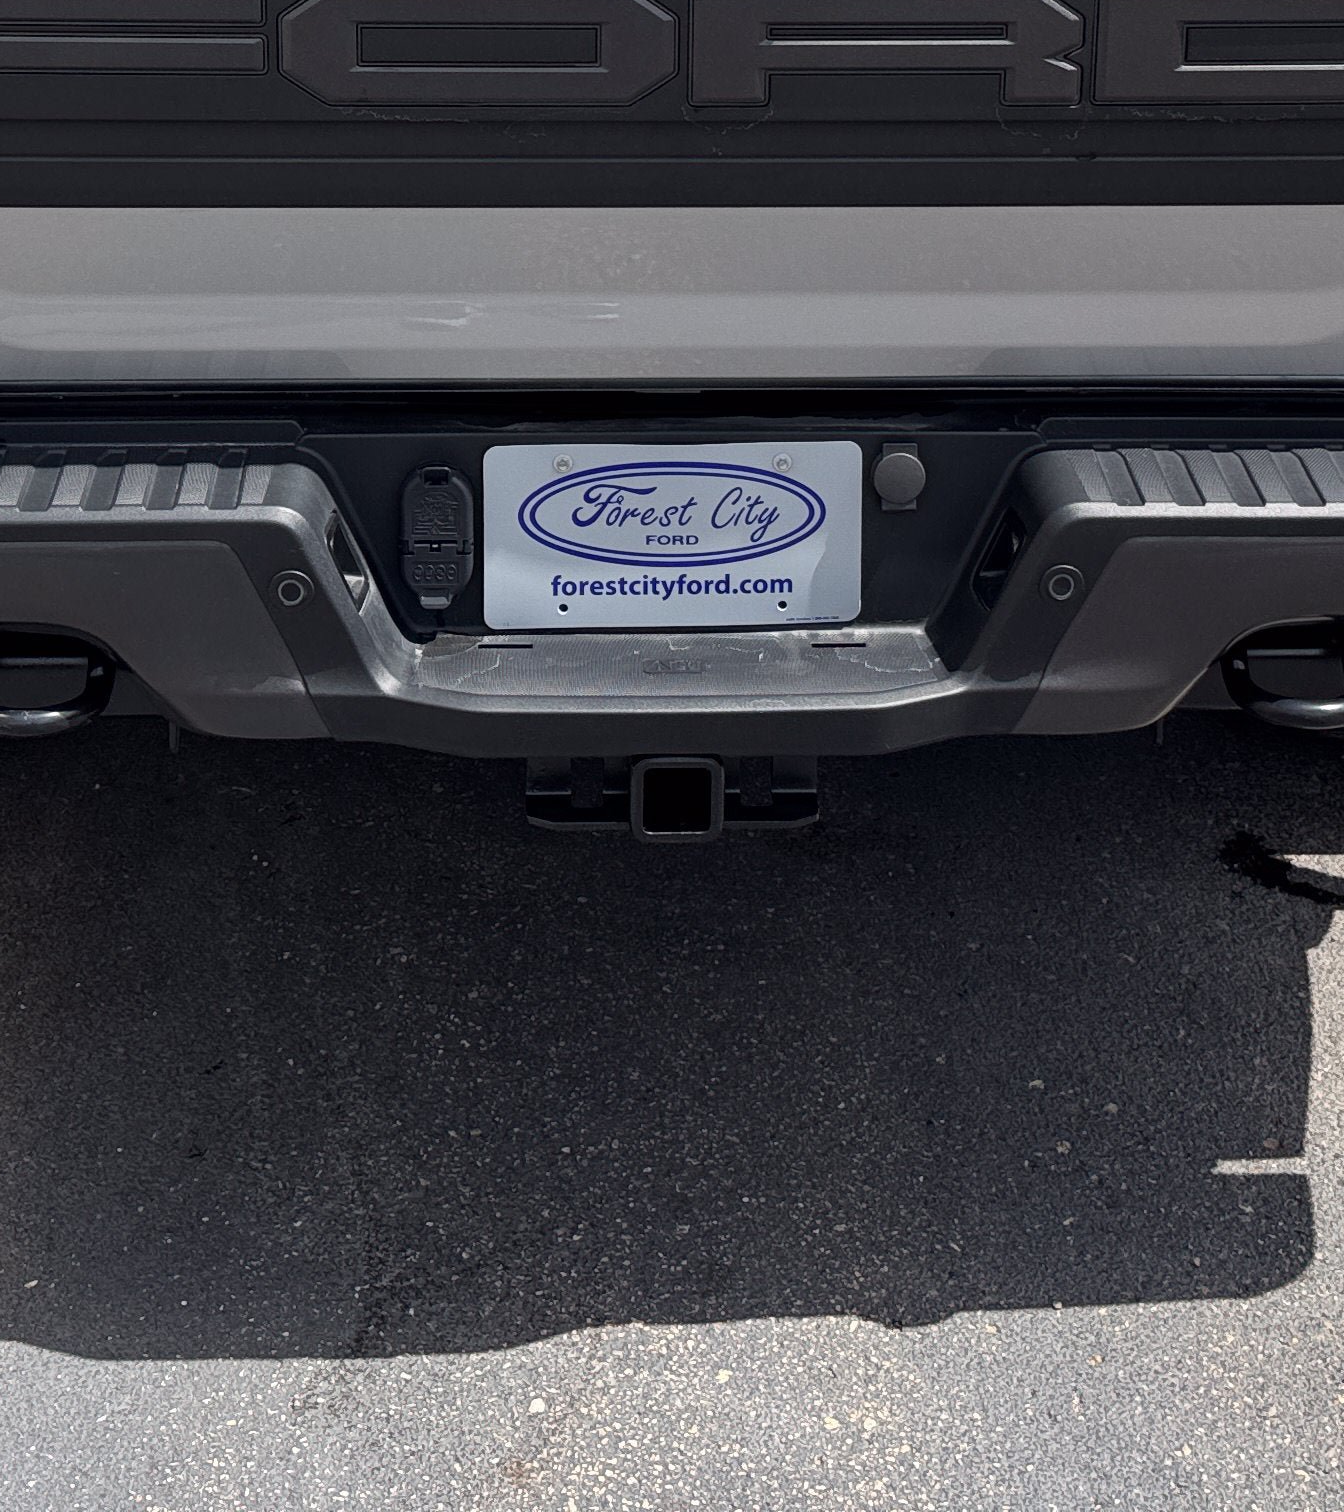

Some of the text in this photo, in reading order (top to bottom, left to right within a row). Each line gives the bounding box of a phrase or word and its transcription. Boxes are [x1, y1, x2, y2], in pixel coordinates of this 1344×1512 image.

[571, 484, 781, 543] Forest City
[645, 534, 699, 546] FORD
[551, 573, 794, 600] forestcityford.com
